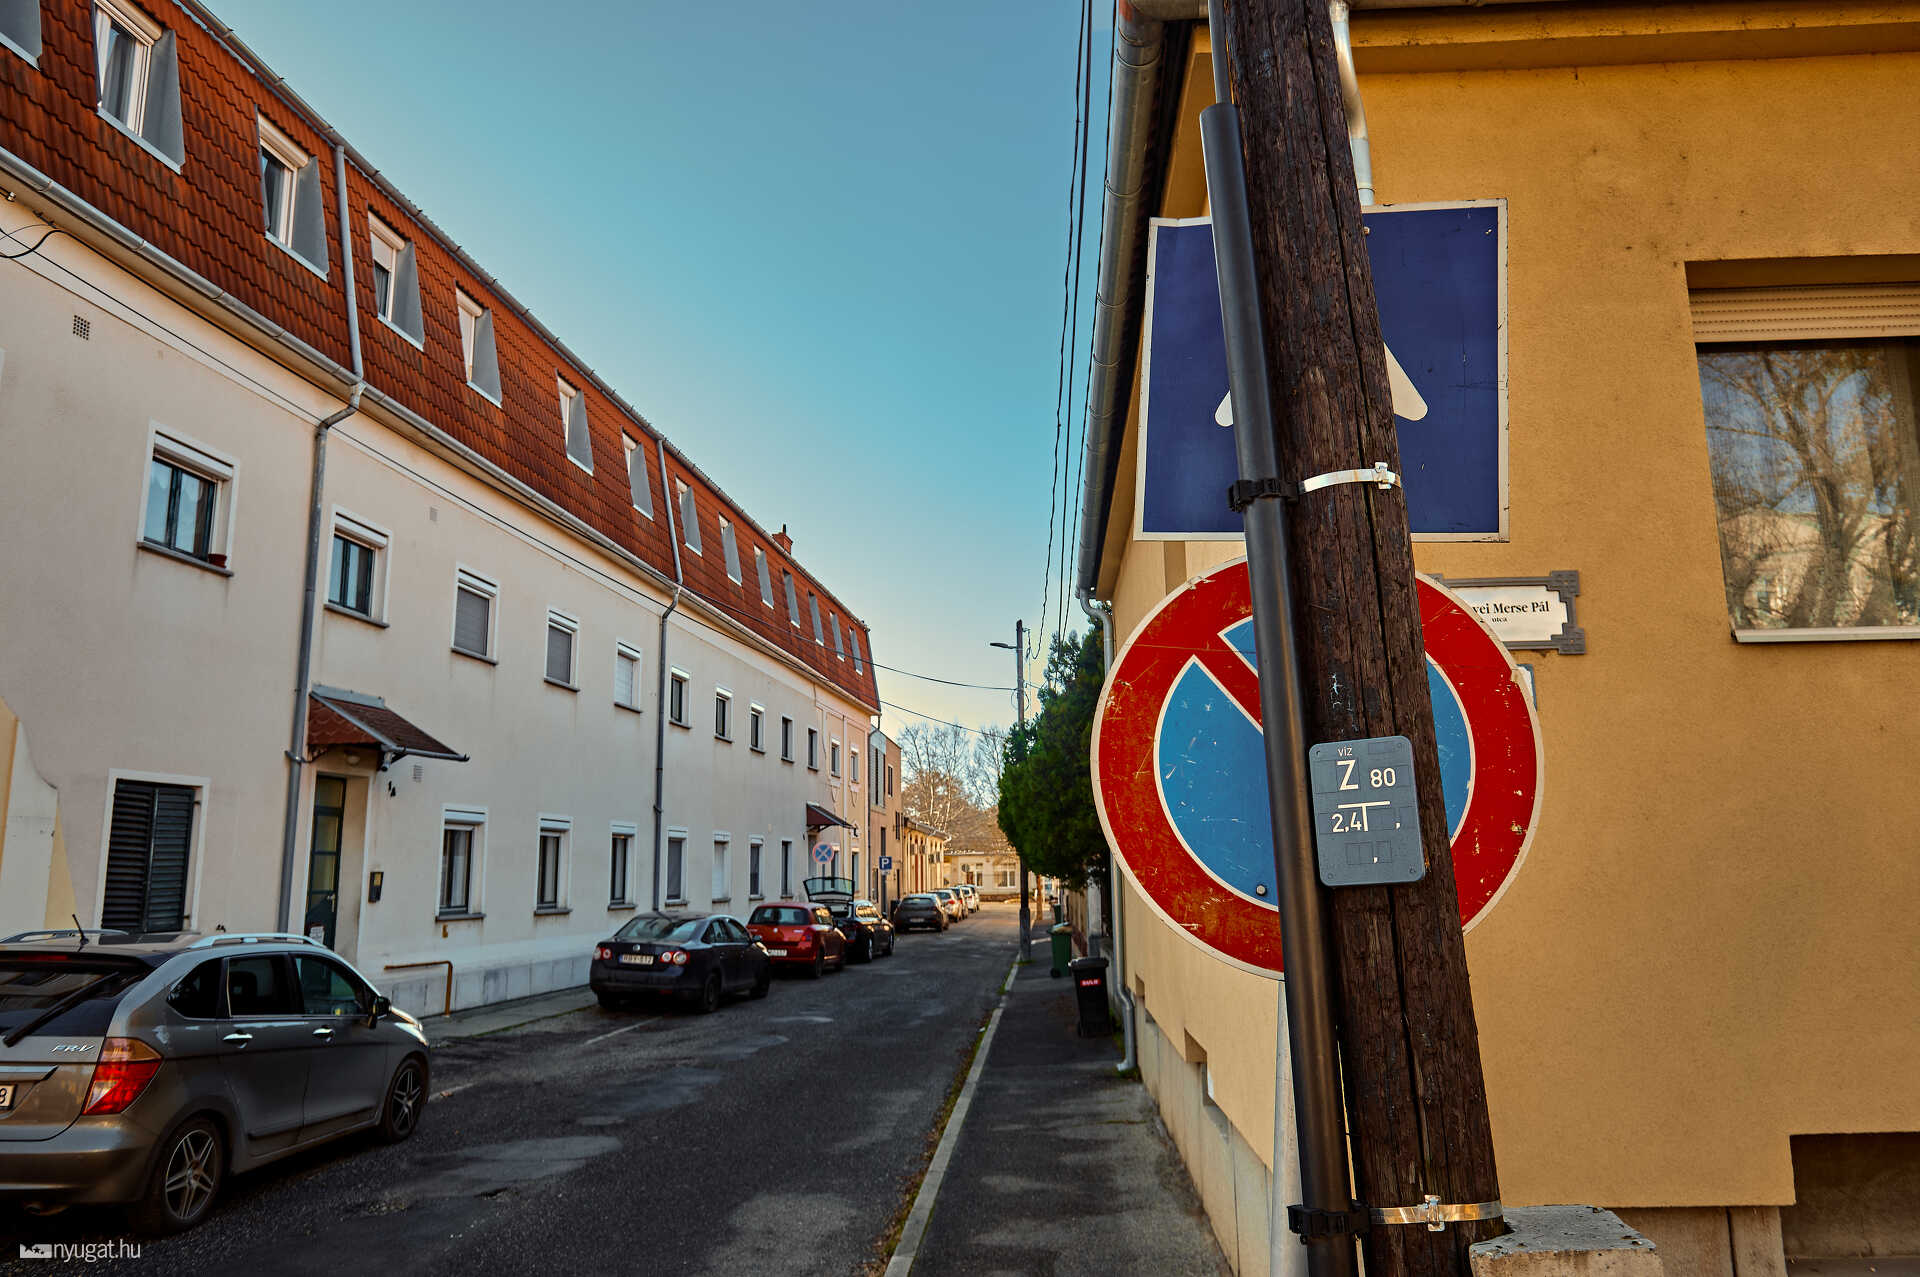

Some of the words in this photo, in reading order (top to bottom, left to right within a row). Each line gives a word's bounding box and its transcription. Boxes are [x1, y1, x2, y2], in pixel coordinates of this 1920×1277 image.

[1493, 603, 1528, 613] Merse
[1532, 601, 1549, 612] Pál
[1336, 760, 1359, 790] Z
[1370, 768, 1396, 788] 80
[882, 858, 889, 868] P
